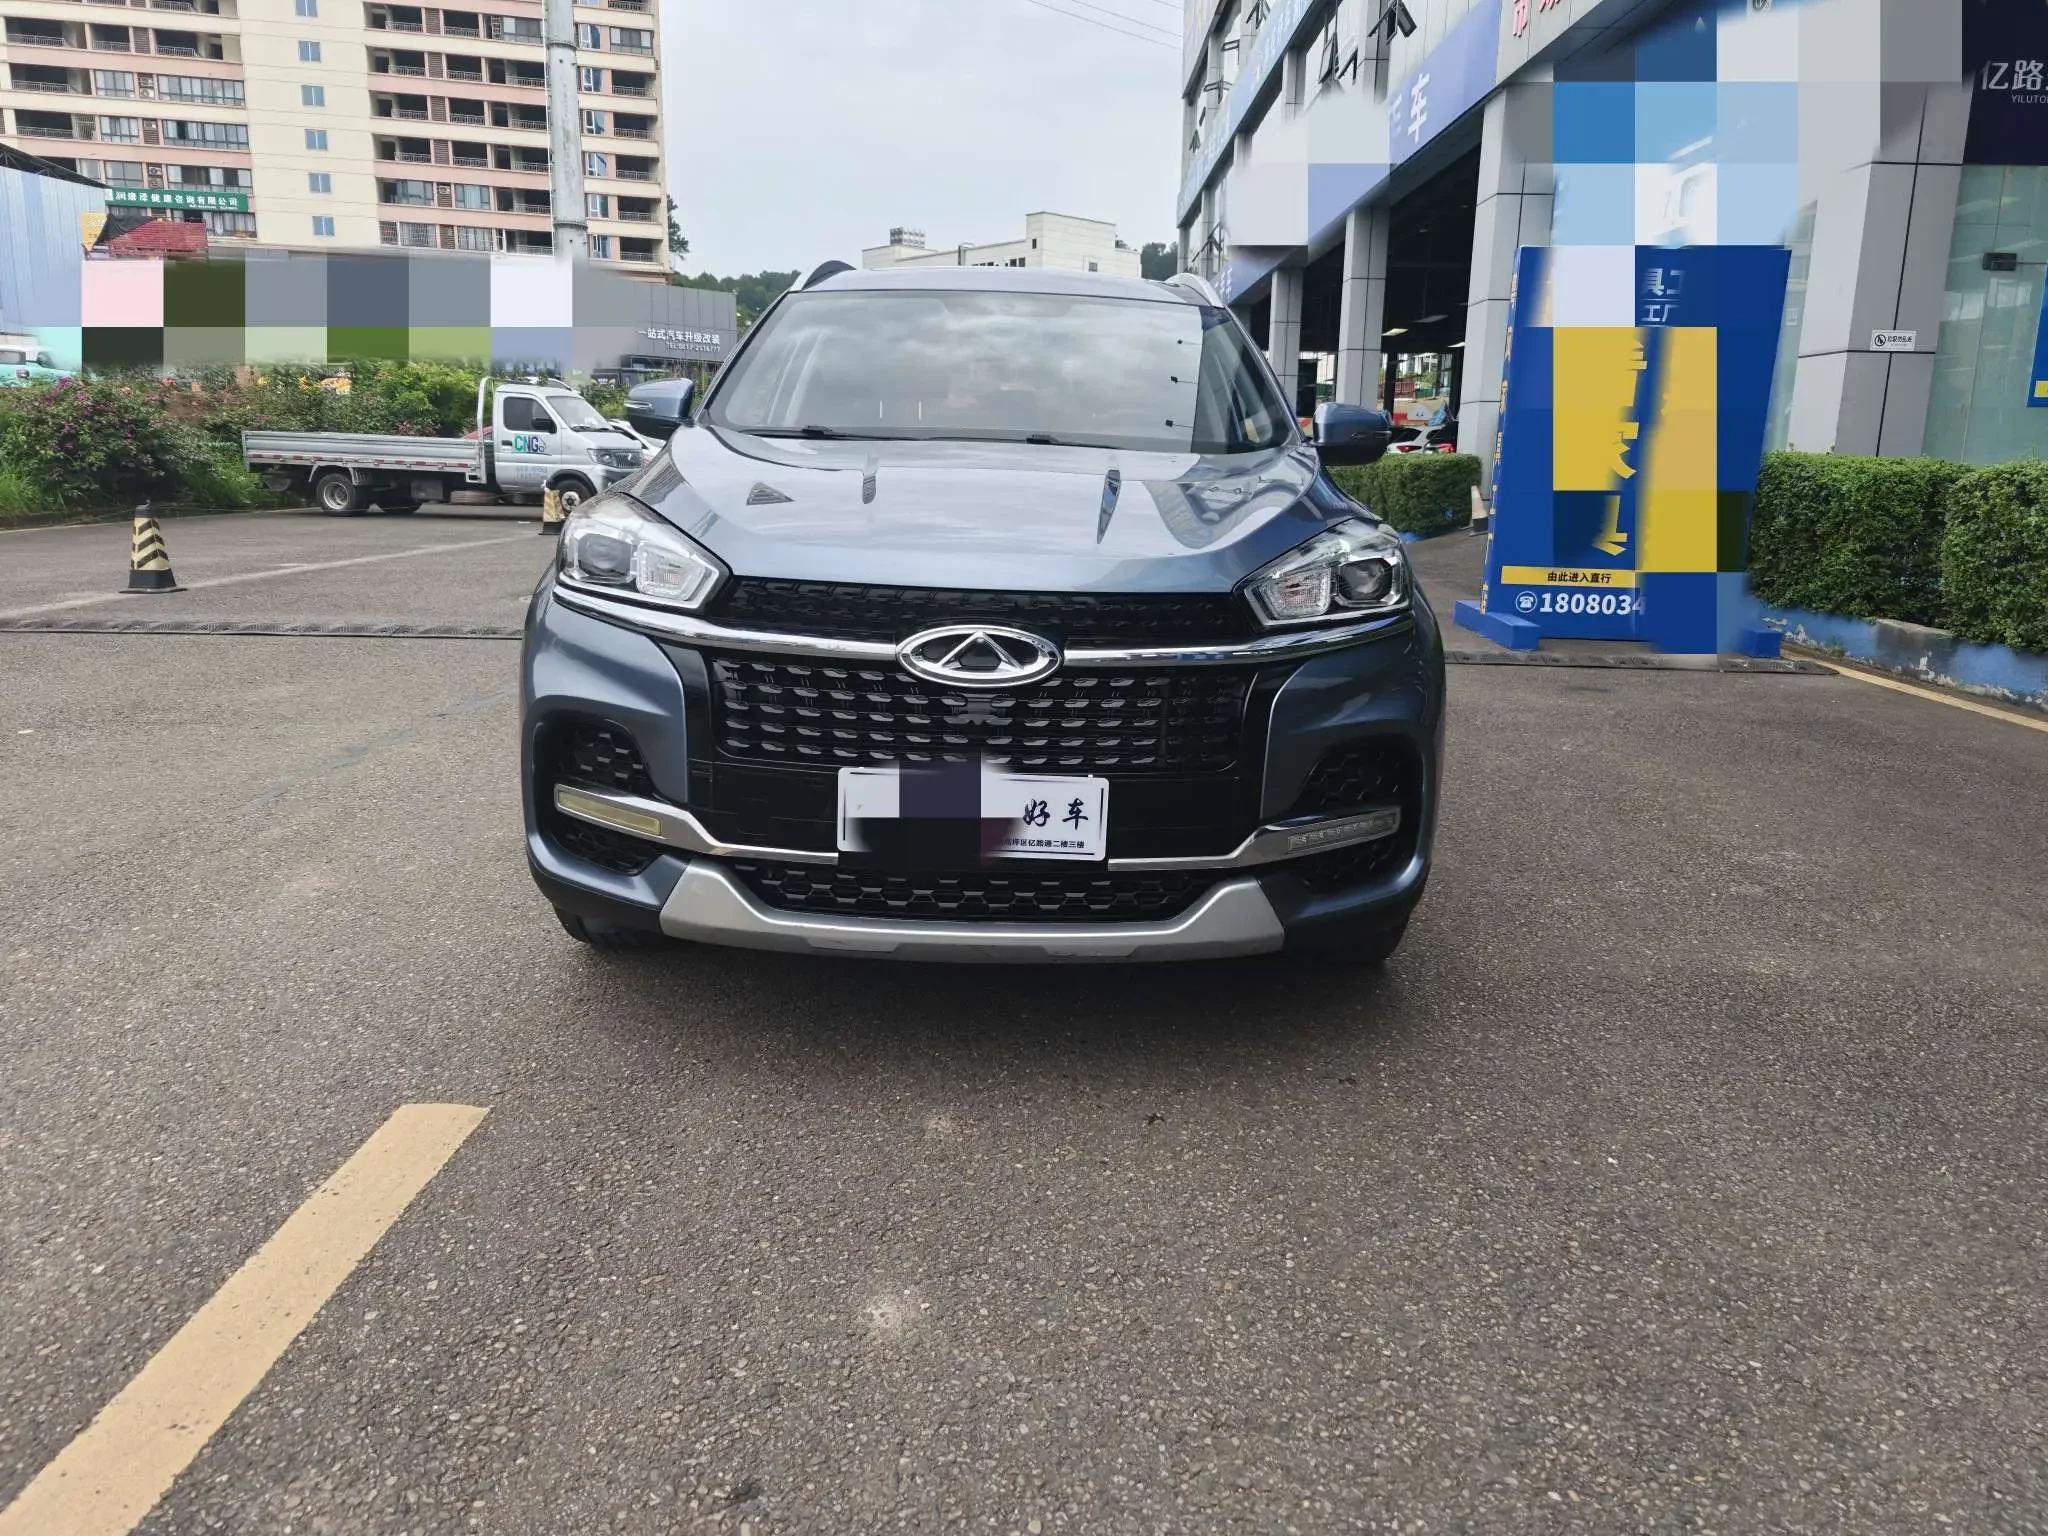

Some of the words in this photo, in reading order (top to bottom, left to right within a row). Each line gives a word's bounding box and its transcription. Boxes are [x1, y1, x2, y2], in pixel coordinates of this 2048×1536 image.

[1981, 59, 2048, 90] 亿路
[2011, 94, 2048, 104] YILUTO
[514, 435, 539, 452] CNG
[1547, 570, 1612, 584] 由此进入直行
